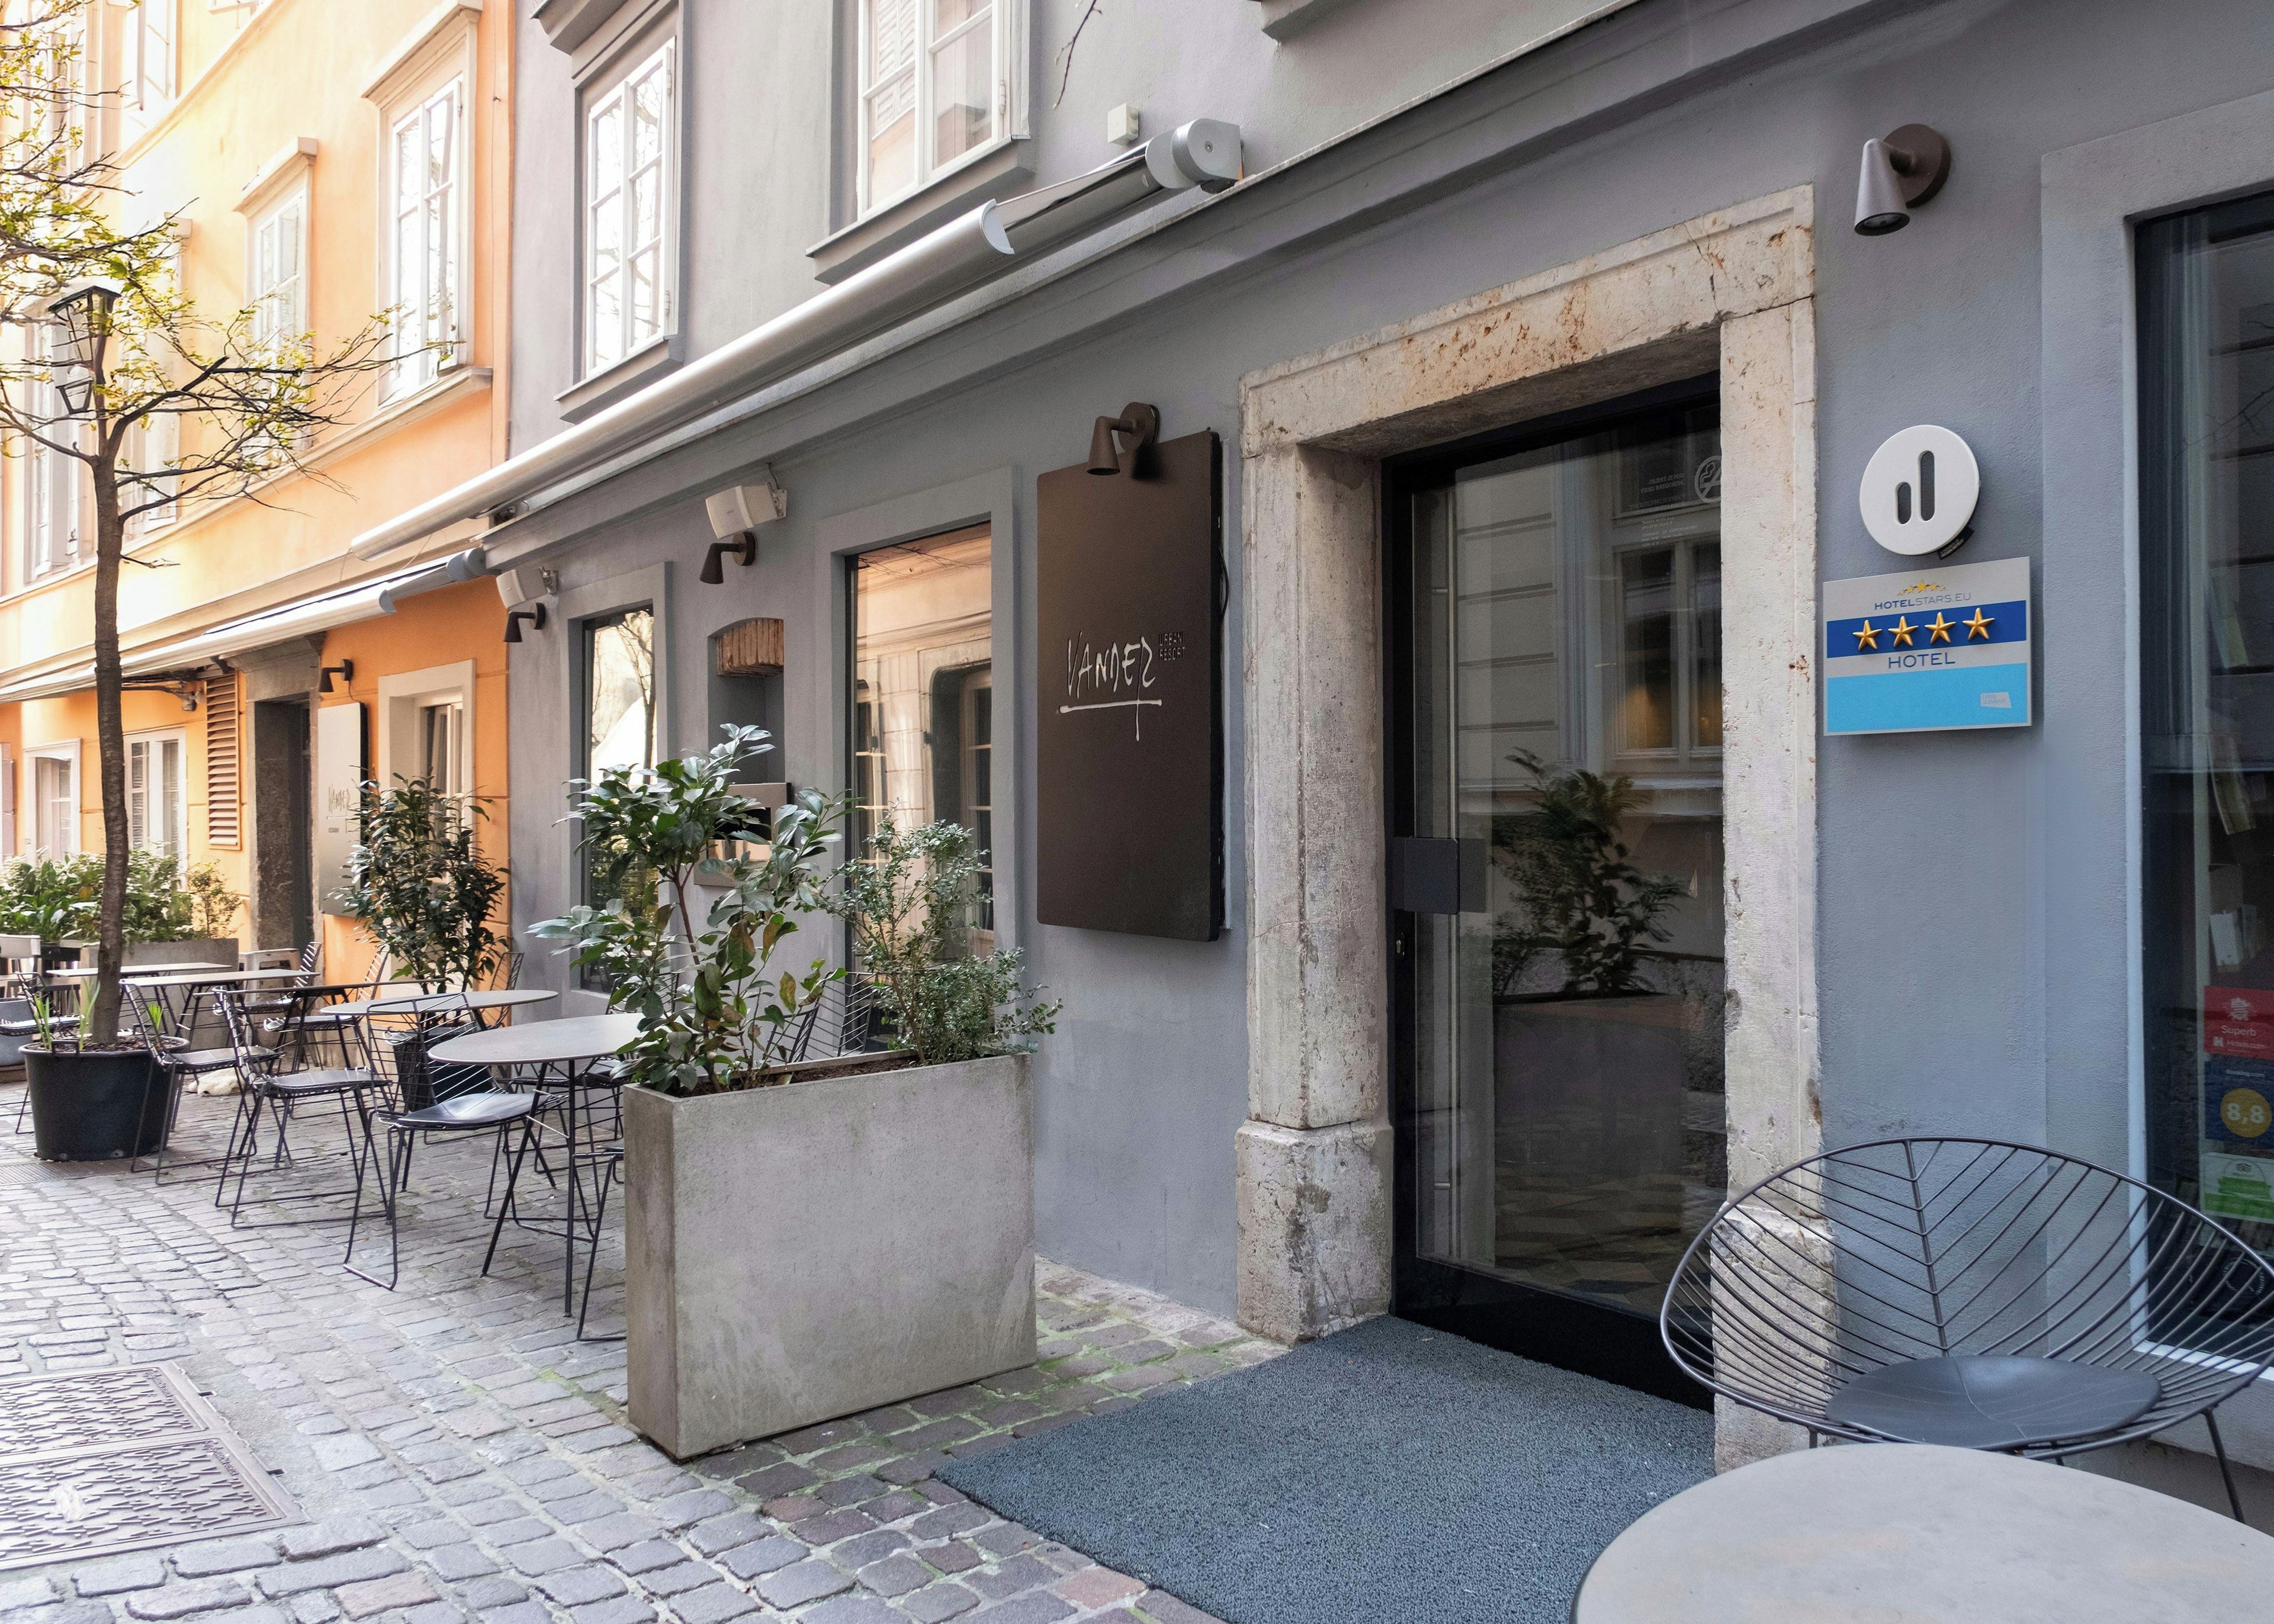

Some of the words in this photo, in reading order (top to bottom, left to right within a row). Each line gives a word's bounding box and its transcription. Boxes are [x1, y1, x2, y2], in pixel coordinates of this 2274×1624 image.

[1874, 592, 1971, 610] HOTELSTARS.EU
[1158, 631, 1184, 647] URBAN
[1158, 647, 1185, 661] RESORT
[1888, 652, 1956, 669] HOTEL
[2221, 1025, 2257, 1036] Superb
[2226, 1102, 2265, 1124] 8,8
